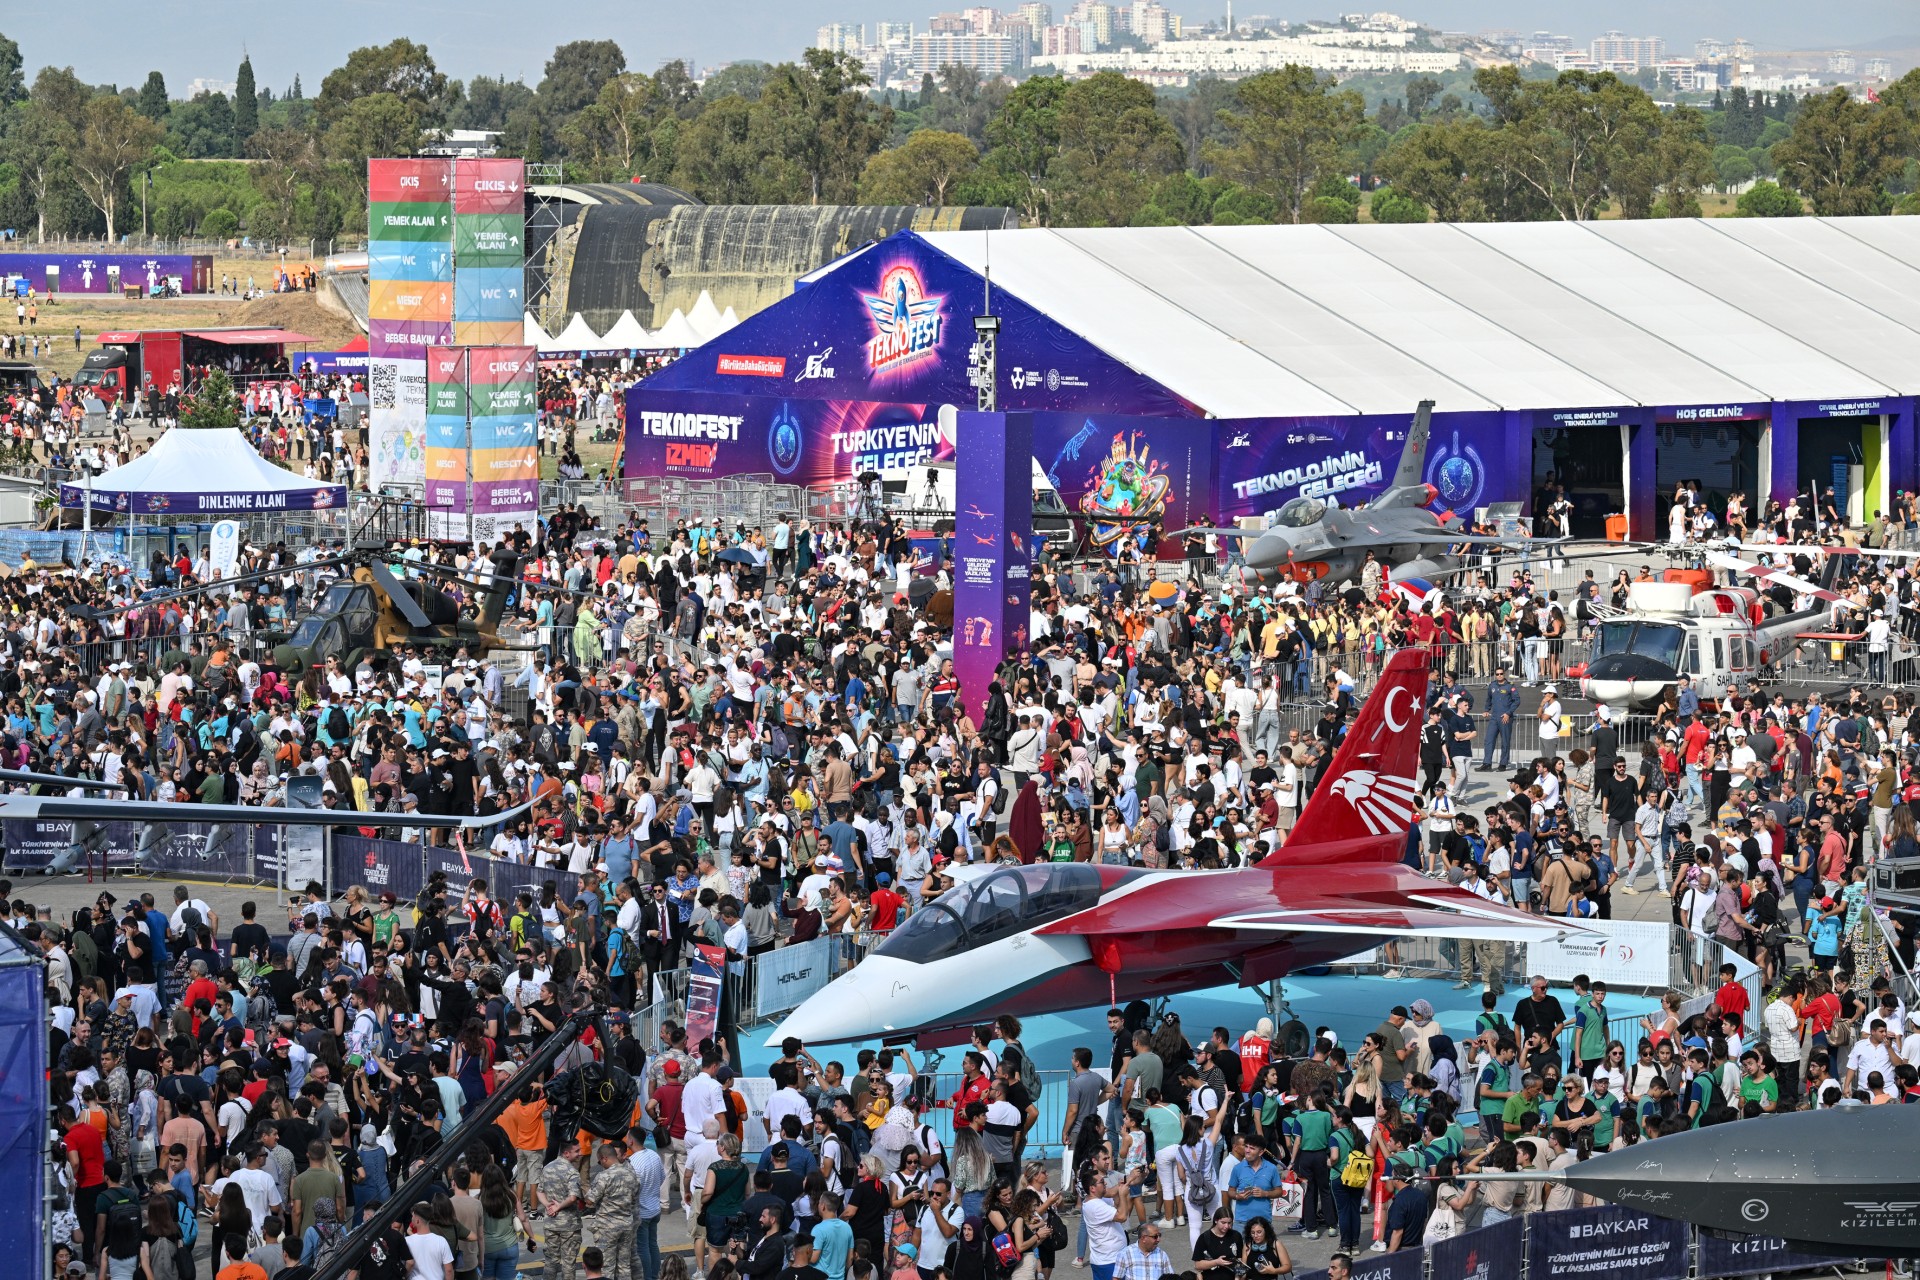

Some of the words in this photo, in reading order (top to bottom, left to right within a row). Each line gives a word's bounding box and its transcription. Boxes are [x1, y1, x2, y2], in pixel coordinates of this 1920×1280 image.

[474, 180, 505, 193] ÇIKIŞ
[384, 216, 410, 226] YEMEK
[411, 216, 435, 226] ALANI
[474, 232, 507, 241] YEMEK
[476, 241, 505, 250] ALANI
[402, 255, 416, 266] WC
[480, 288, 502, 299] WC
[385, 333, 408, 345] BEBEK
[410, 333, 436, 345] BAKIM
[869, 314, 943, 368] TEKNOFEST
[489, 361, 519, 374] ÇIKIŞ
[488, 391, 521, 400] YEMEK
[490, 400, 519, 408] ALANI
[1676, 409, 1697, 420] HOŞ
[1699, 405, 1743, 418] GELDİNİZ
[440, 425, 453, 436] WC
[495, 425, 516, 436] WC
[641, 411, 743, 441] TEKNOFEST
[831, 422, 942, 454] TÜRKİYE'NİN
[666, 442, 714, 467] İZMİR
[1233, 450, 1365, 499] TEKNOLOJİNİN
[1299, 461, 1383, 500] GELECEĞİ
[491, 487, 521, 497] BEBEK
[199, 495, 252, 509] DİNLENME
[255, 493, 286, 507] ALANI
[491, 496, 521, 506] BAKIM
[21, 840, 64, 848] TÜRKİYE'NİN
[22, 848, 54, 856] TAARRUZ
[752, 1109, 764, 1117] TÜR
[1582, 1218, 1648, 1238] BAYKAR
[1840, 1218, 1920, 1228] KIZILELM
[1547, 1249, 1601, 1263] TÜRKİYE'NİN
[1603, 1246, 1626, 1258] MİLLİ
[1627, 1245, 1639, 1255] VE
[1640, 1241, 1670, 1254] ÖZGÜN
[1551, 1264, 1566, 1274] İLK
[1566, 1260, 1608, 1273] İNSANSIZ
[1610, 1258, 1638, 1271] SAVAŞ
[1640, 1253, 1665, 1266] UÇAĞI
[1349, 1266, 1391, 1280] AYKAR
